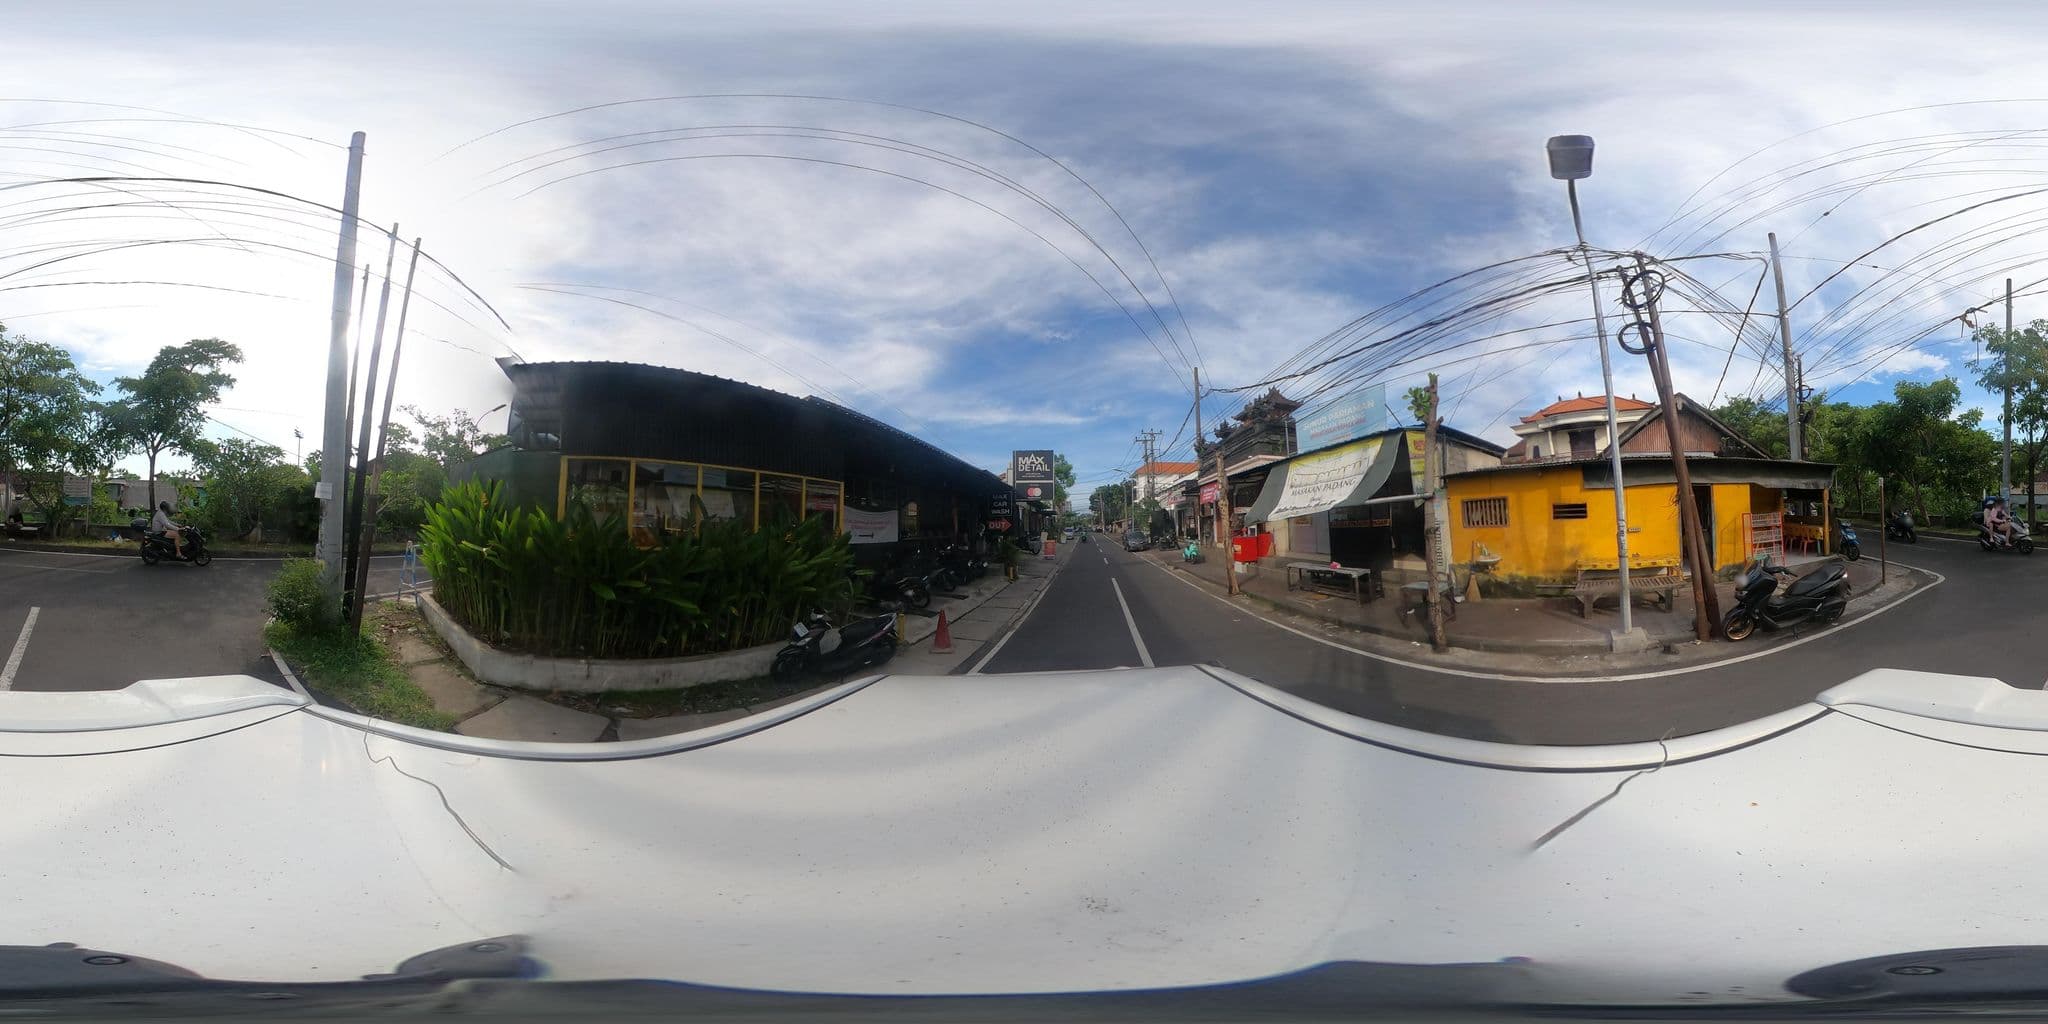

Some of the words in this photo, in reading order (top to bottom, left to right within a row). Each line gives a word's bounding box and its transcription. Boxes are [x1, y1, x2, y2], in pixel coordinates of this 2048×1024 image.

[1018, 453, 1044, 465] MAX
[1018, 464, 1050, 472] DETAIL
[1323, 479, 1356, 492] PADANG
[988, 521, 1006, 529] OUT
